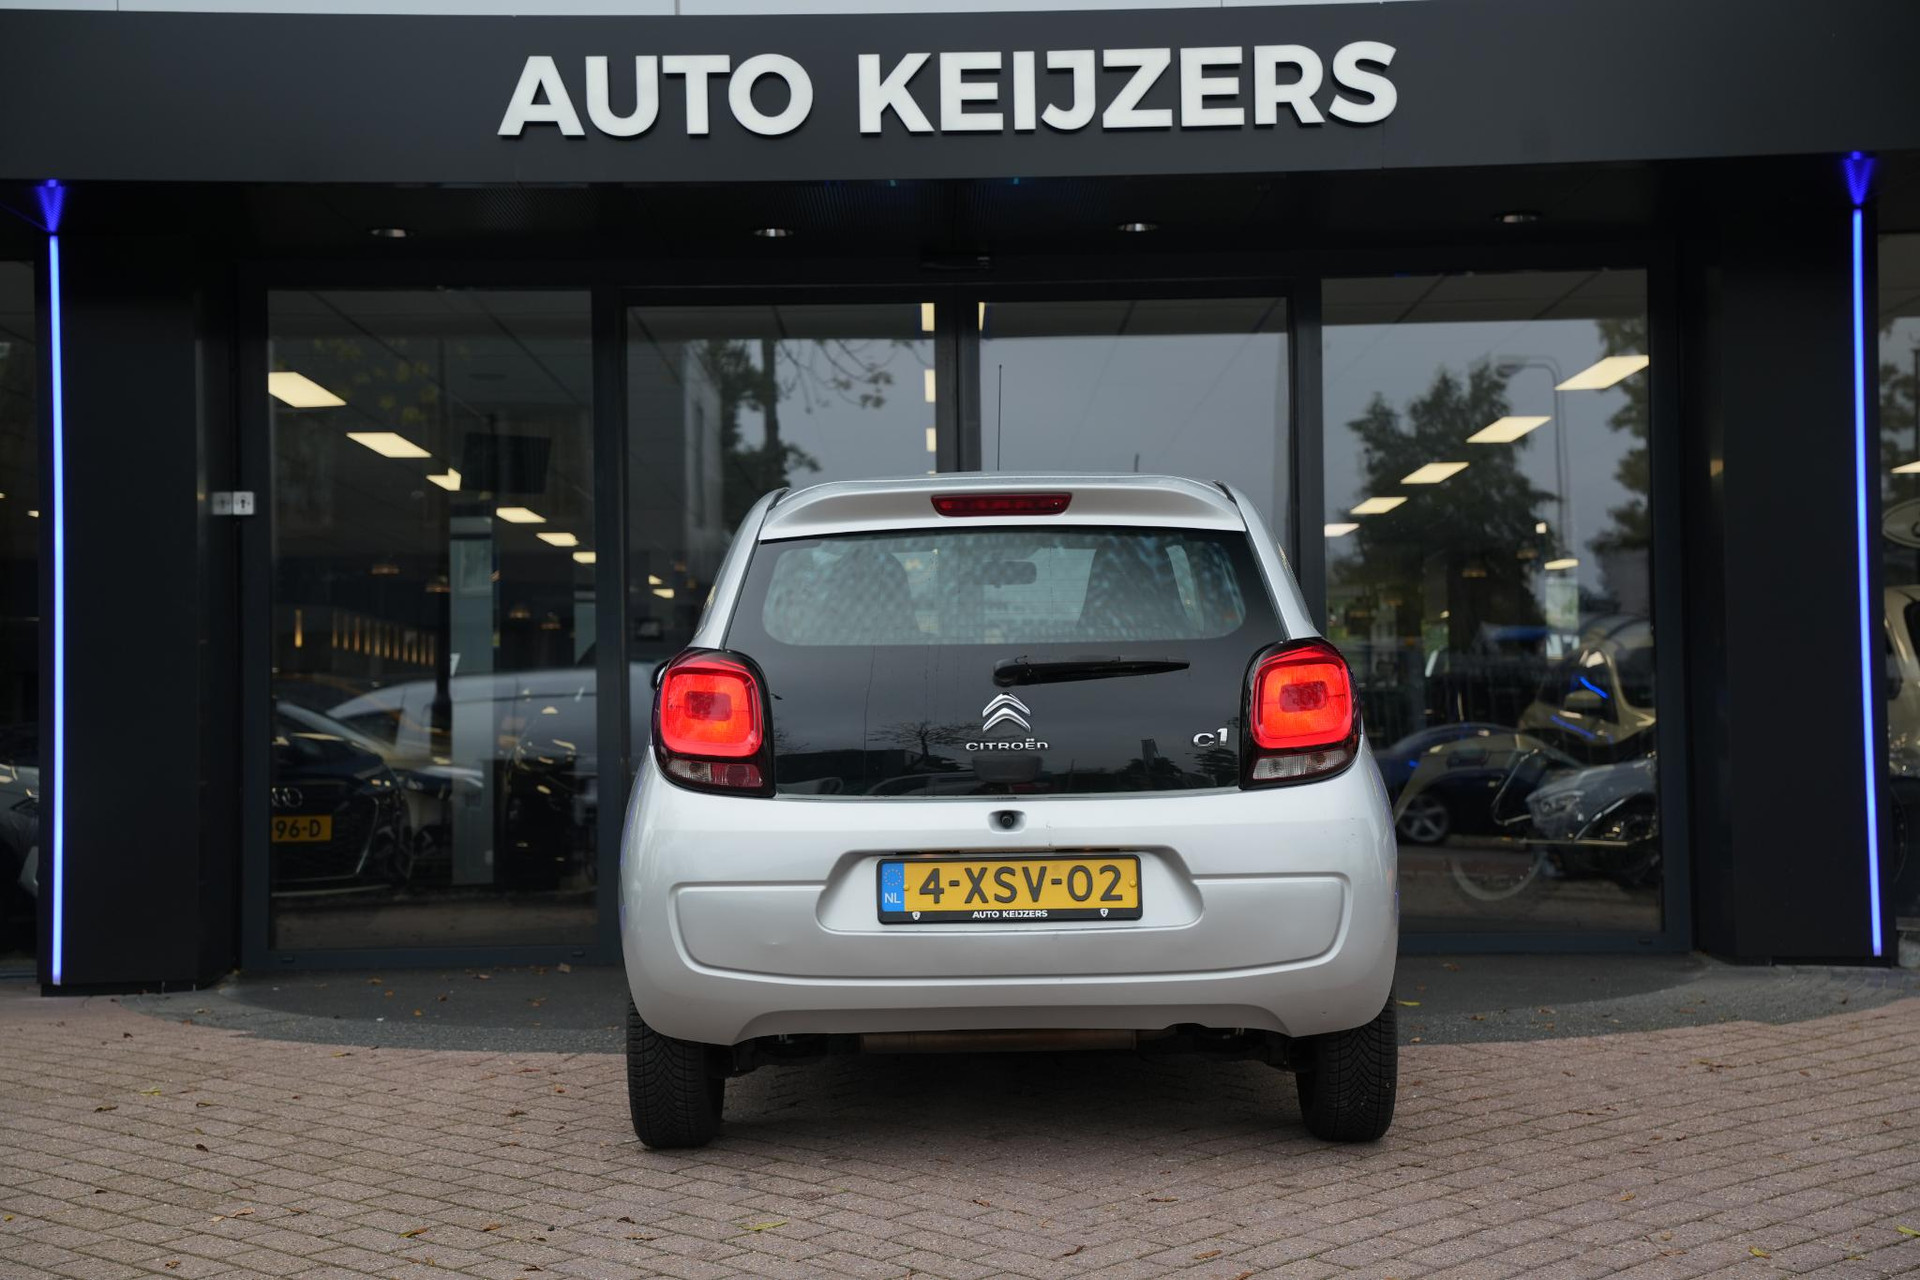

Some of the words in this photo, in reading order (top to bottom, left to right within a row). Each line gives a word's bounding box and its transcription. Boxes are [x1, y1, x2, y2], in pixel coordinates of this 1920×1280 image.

[497, 53, 814, 138] AUTO
[858, 40, 1399, 135] KEIJZERS
[1193, 727, 1228, 747] C1
[919, 864, 1123, 905] 4-XSV-02
[884, 892, 901, 904] NL
[1002, 910, 1048, 918] KEIJZERS
